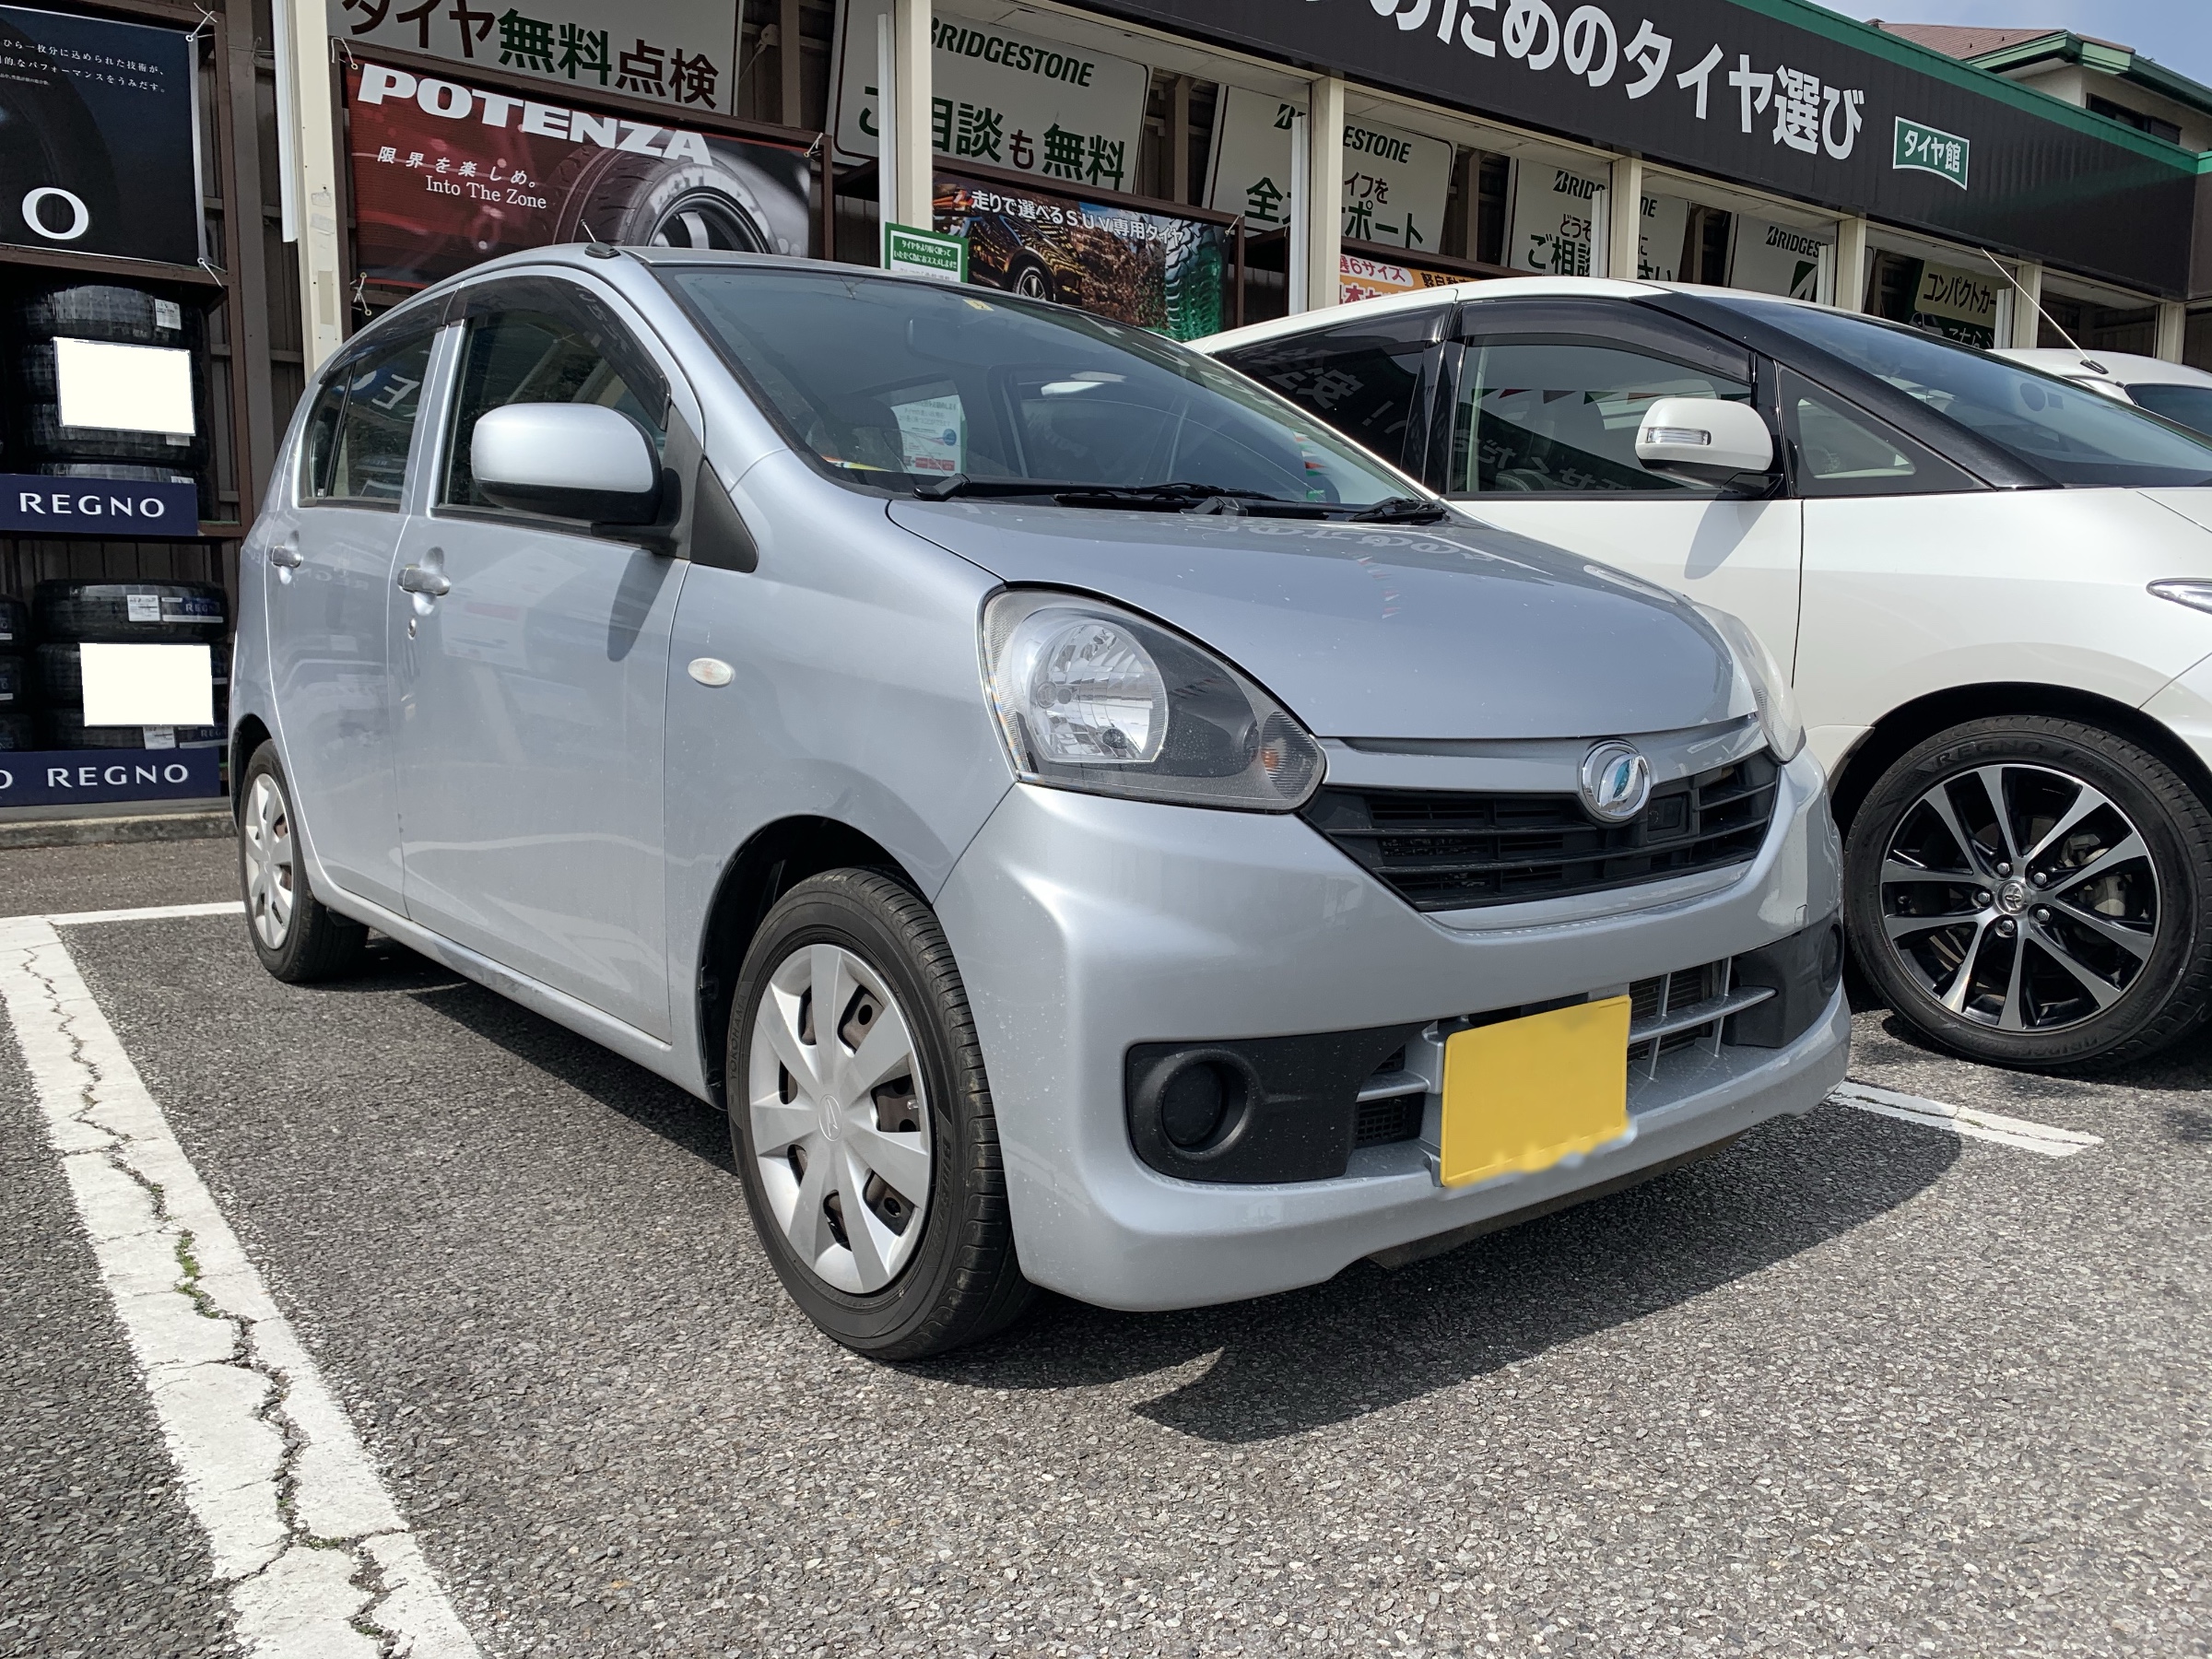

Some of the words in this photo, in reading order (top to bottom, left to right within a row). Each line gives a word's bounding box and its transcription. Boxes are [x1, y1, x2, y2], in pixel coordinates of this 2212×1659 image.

[0, 55, 165, 93] 的なパフォーマンスをうみだす。
[357, 64, 713, 167] POTENZA
[378, 146, 536, 189] 限界を楽しめ。
[1904, 129, 1961, 173] タイヤ館
[426, 175, 461, 196] Into
[466, 182, 501, 202] The
[506, 188, 547, 209] Zone
[22, 187, 89, 240] O
[19, 492, 165, 518] REGNO
[1936, 739, 2044, 769] REGNO
[47, 763, 189, 788] REGNO
